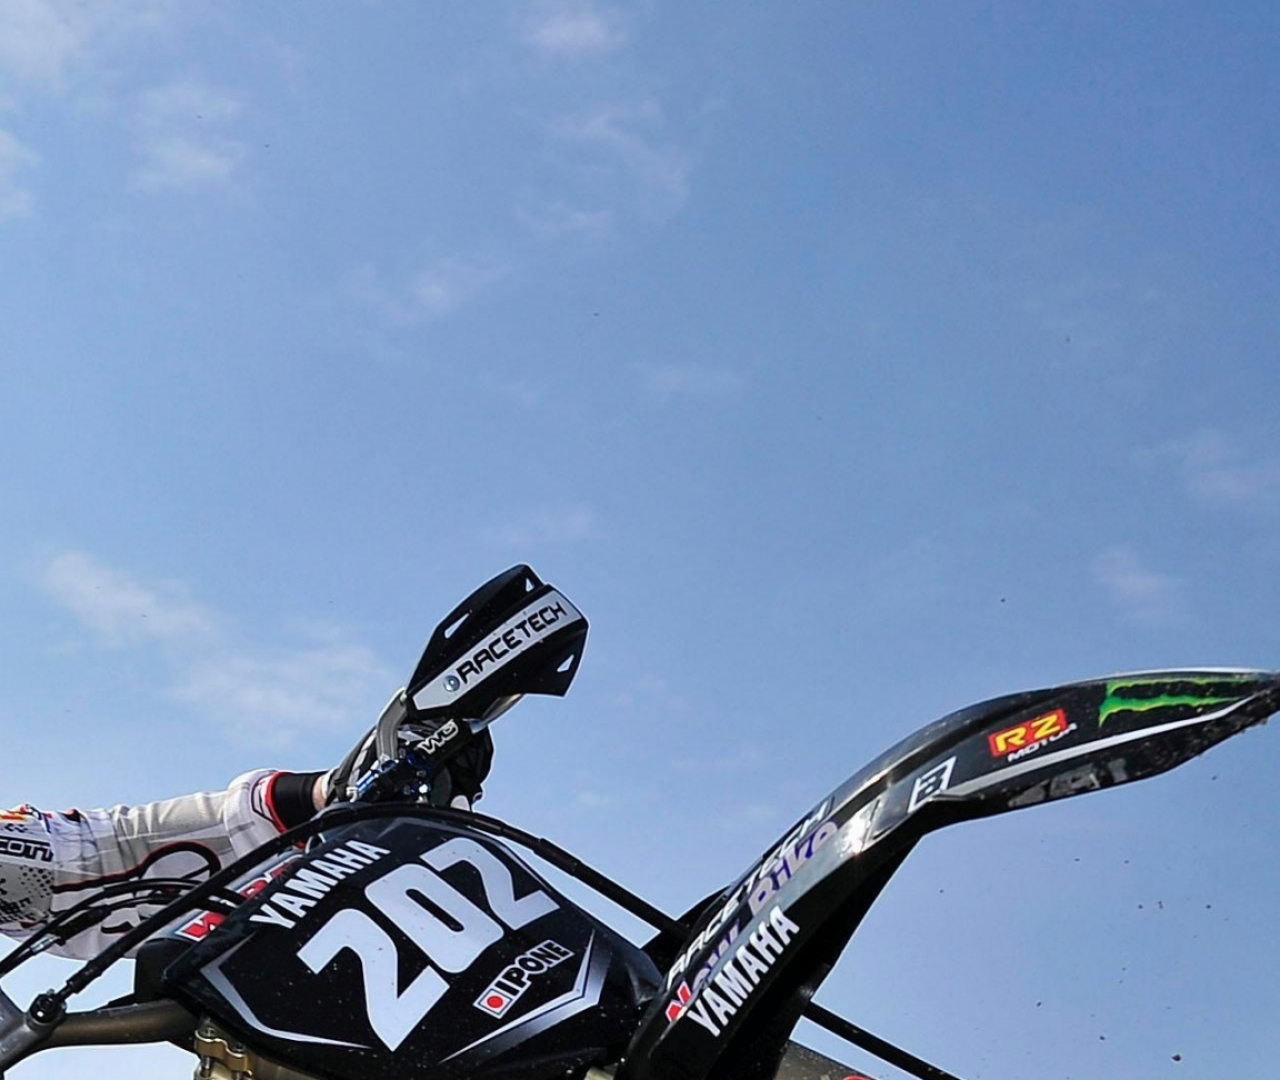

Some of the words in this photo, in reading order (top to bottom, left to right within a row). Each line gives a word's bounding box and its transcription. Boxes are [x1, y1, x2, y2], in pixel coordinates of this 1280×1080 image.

[456, 601, 567, 684] RACETECH
[995, 713, 1061, 752] RZ
[250, 840, 391, 929] YAMAHA
[296, 837, 560, 1051] 202
[494, 941, 572, 997] IPONE
[686, 905, 800, 1038] YAMAHA
